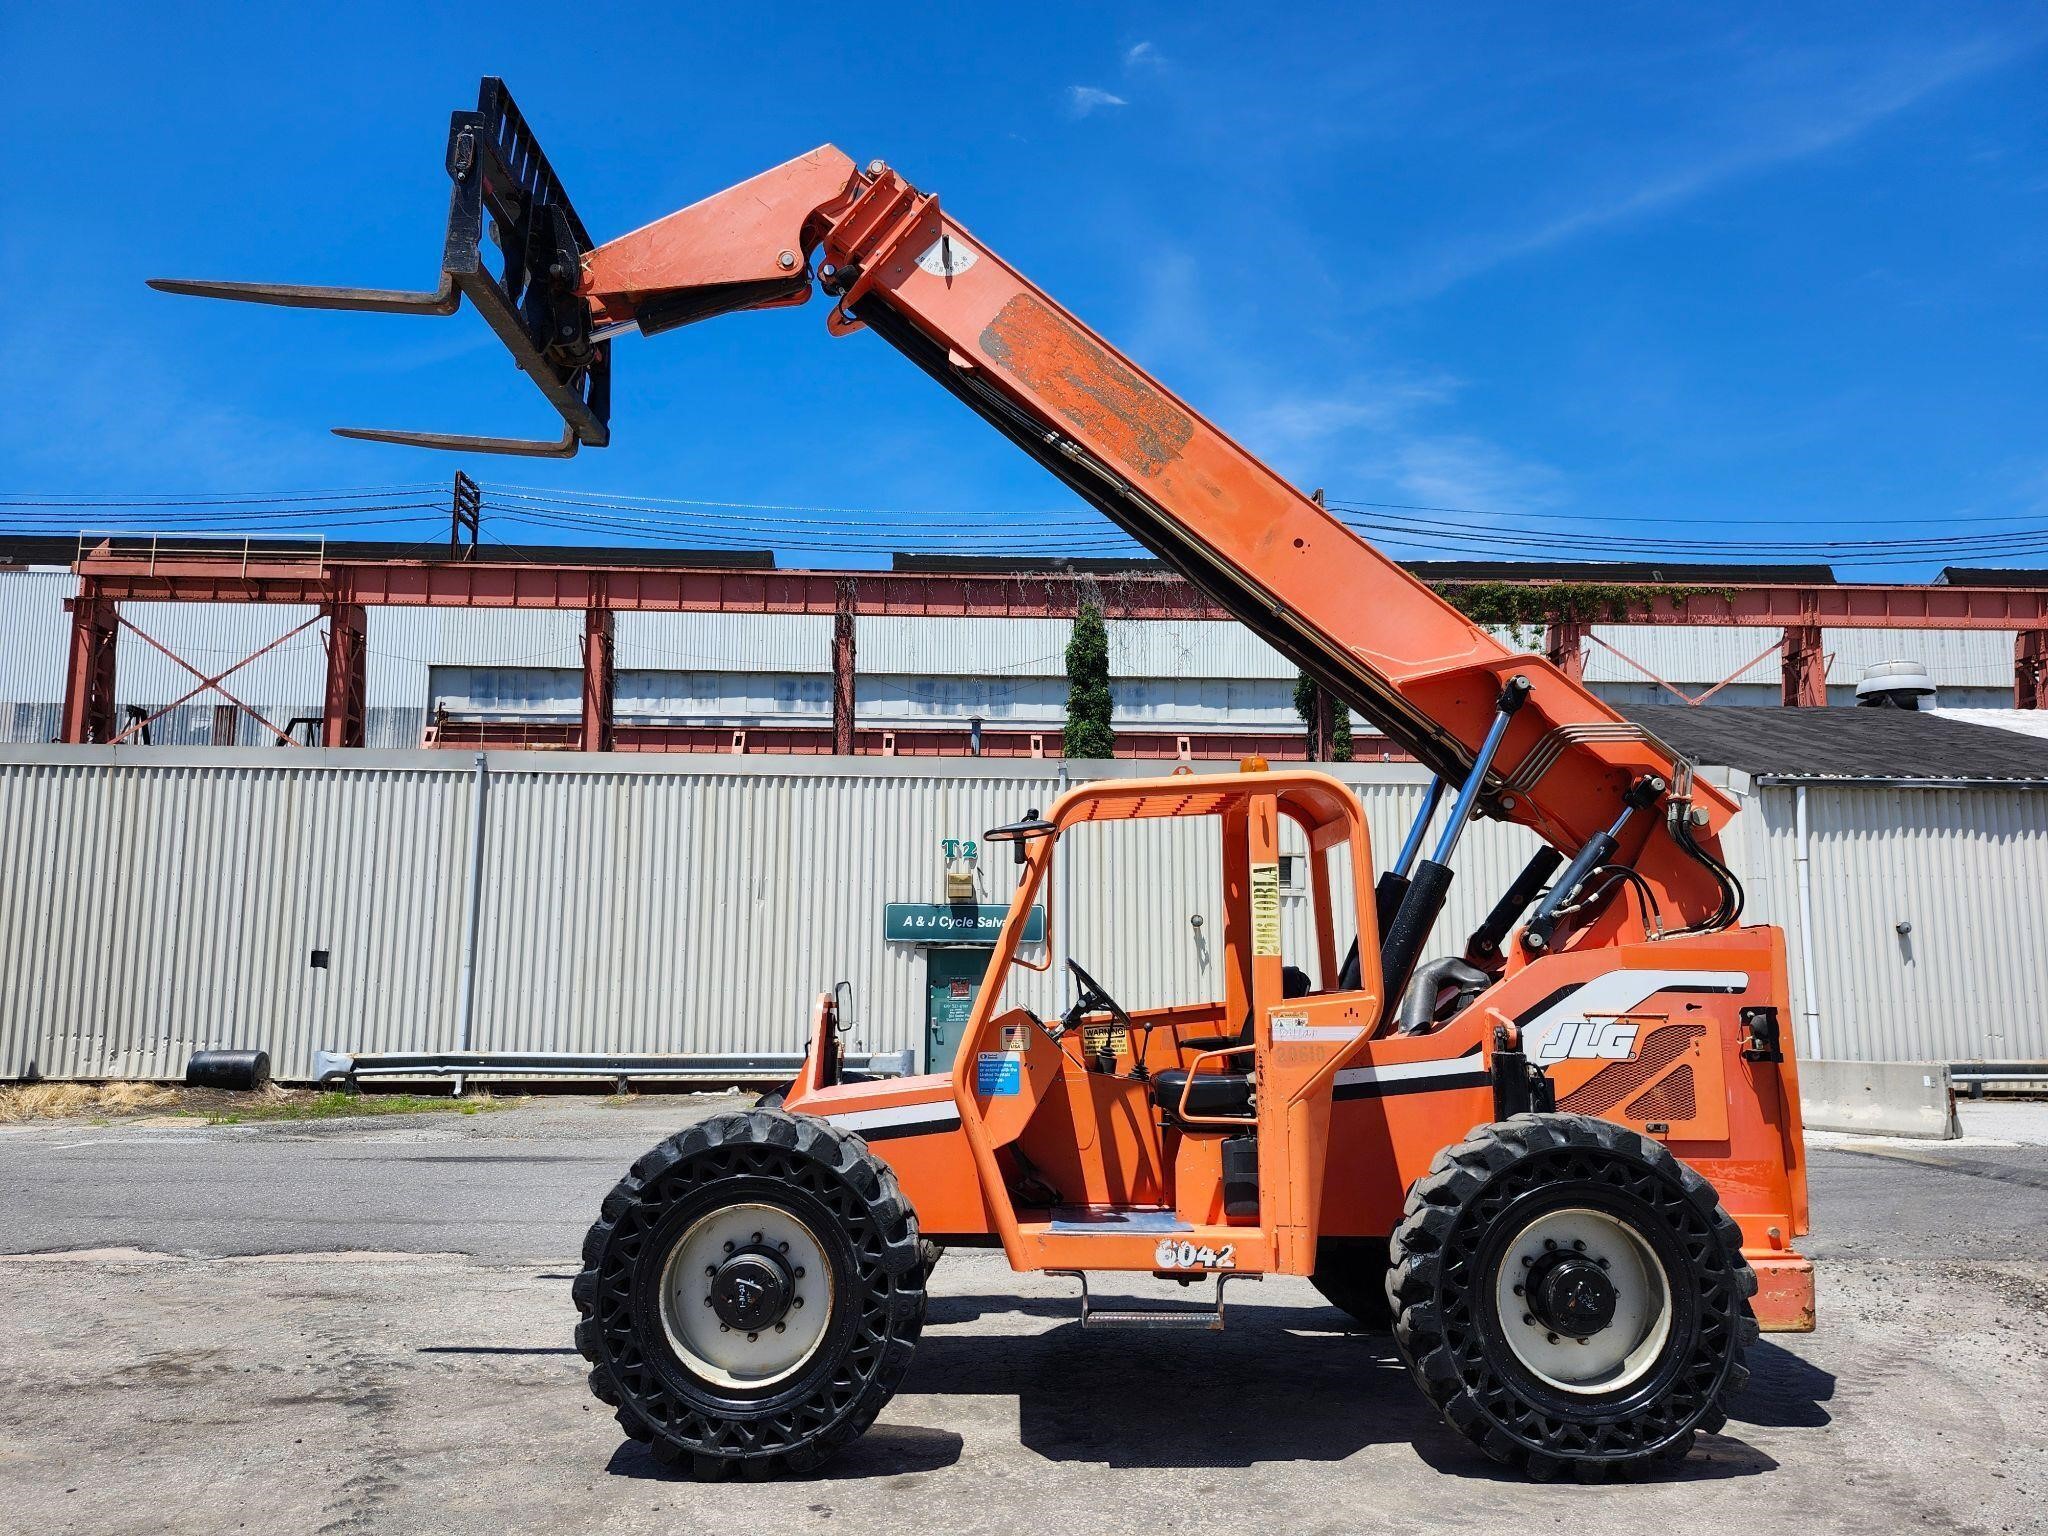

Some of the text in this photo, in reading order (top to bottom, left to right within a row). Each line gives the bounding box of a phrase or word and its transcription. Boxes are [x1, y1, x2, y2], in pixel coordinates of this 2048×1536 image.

[903, 916, 913, 927] A
[915, 916, 925, 927] &
[927, 916, 937, 927] J
[939, 916, 974, 929] Cycle
[1085, 1028, 1124, 1037] WARNNG
[1540, 1023, 1640, 1059] JLG
[1156, 1238, 1236, 1268] 6042
